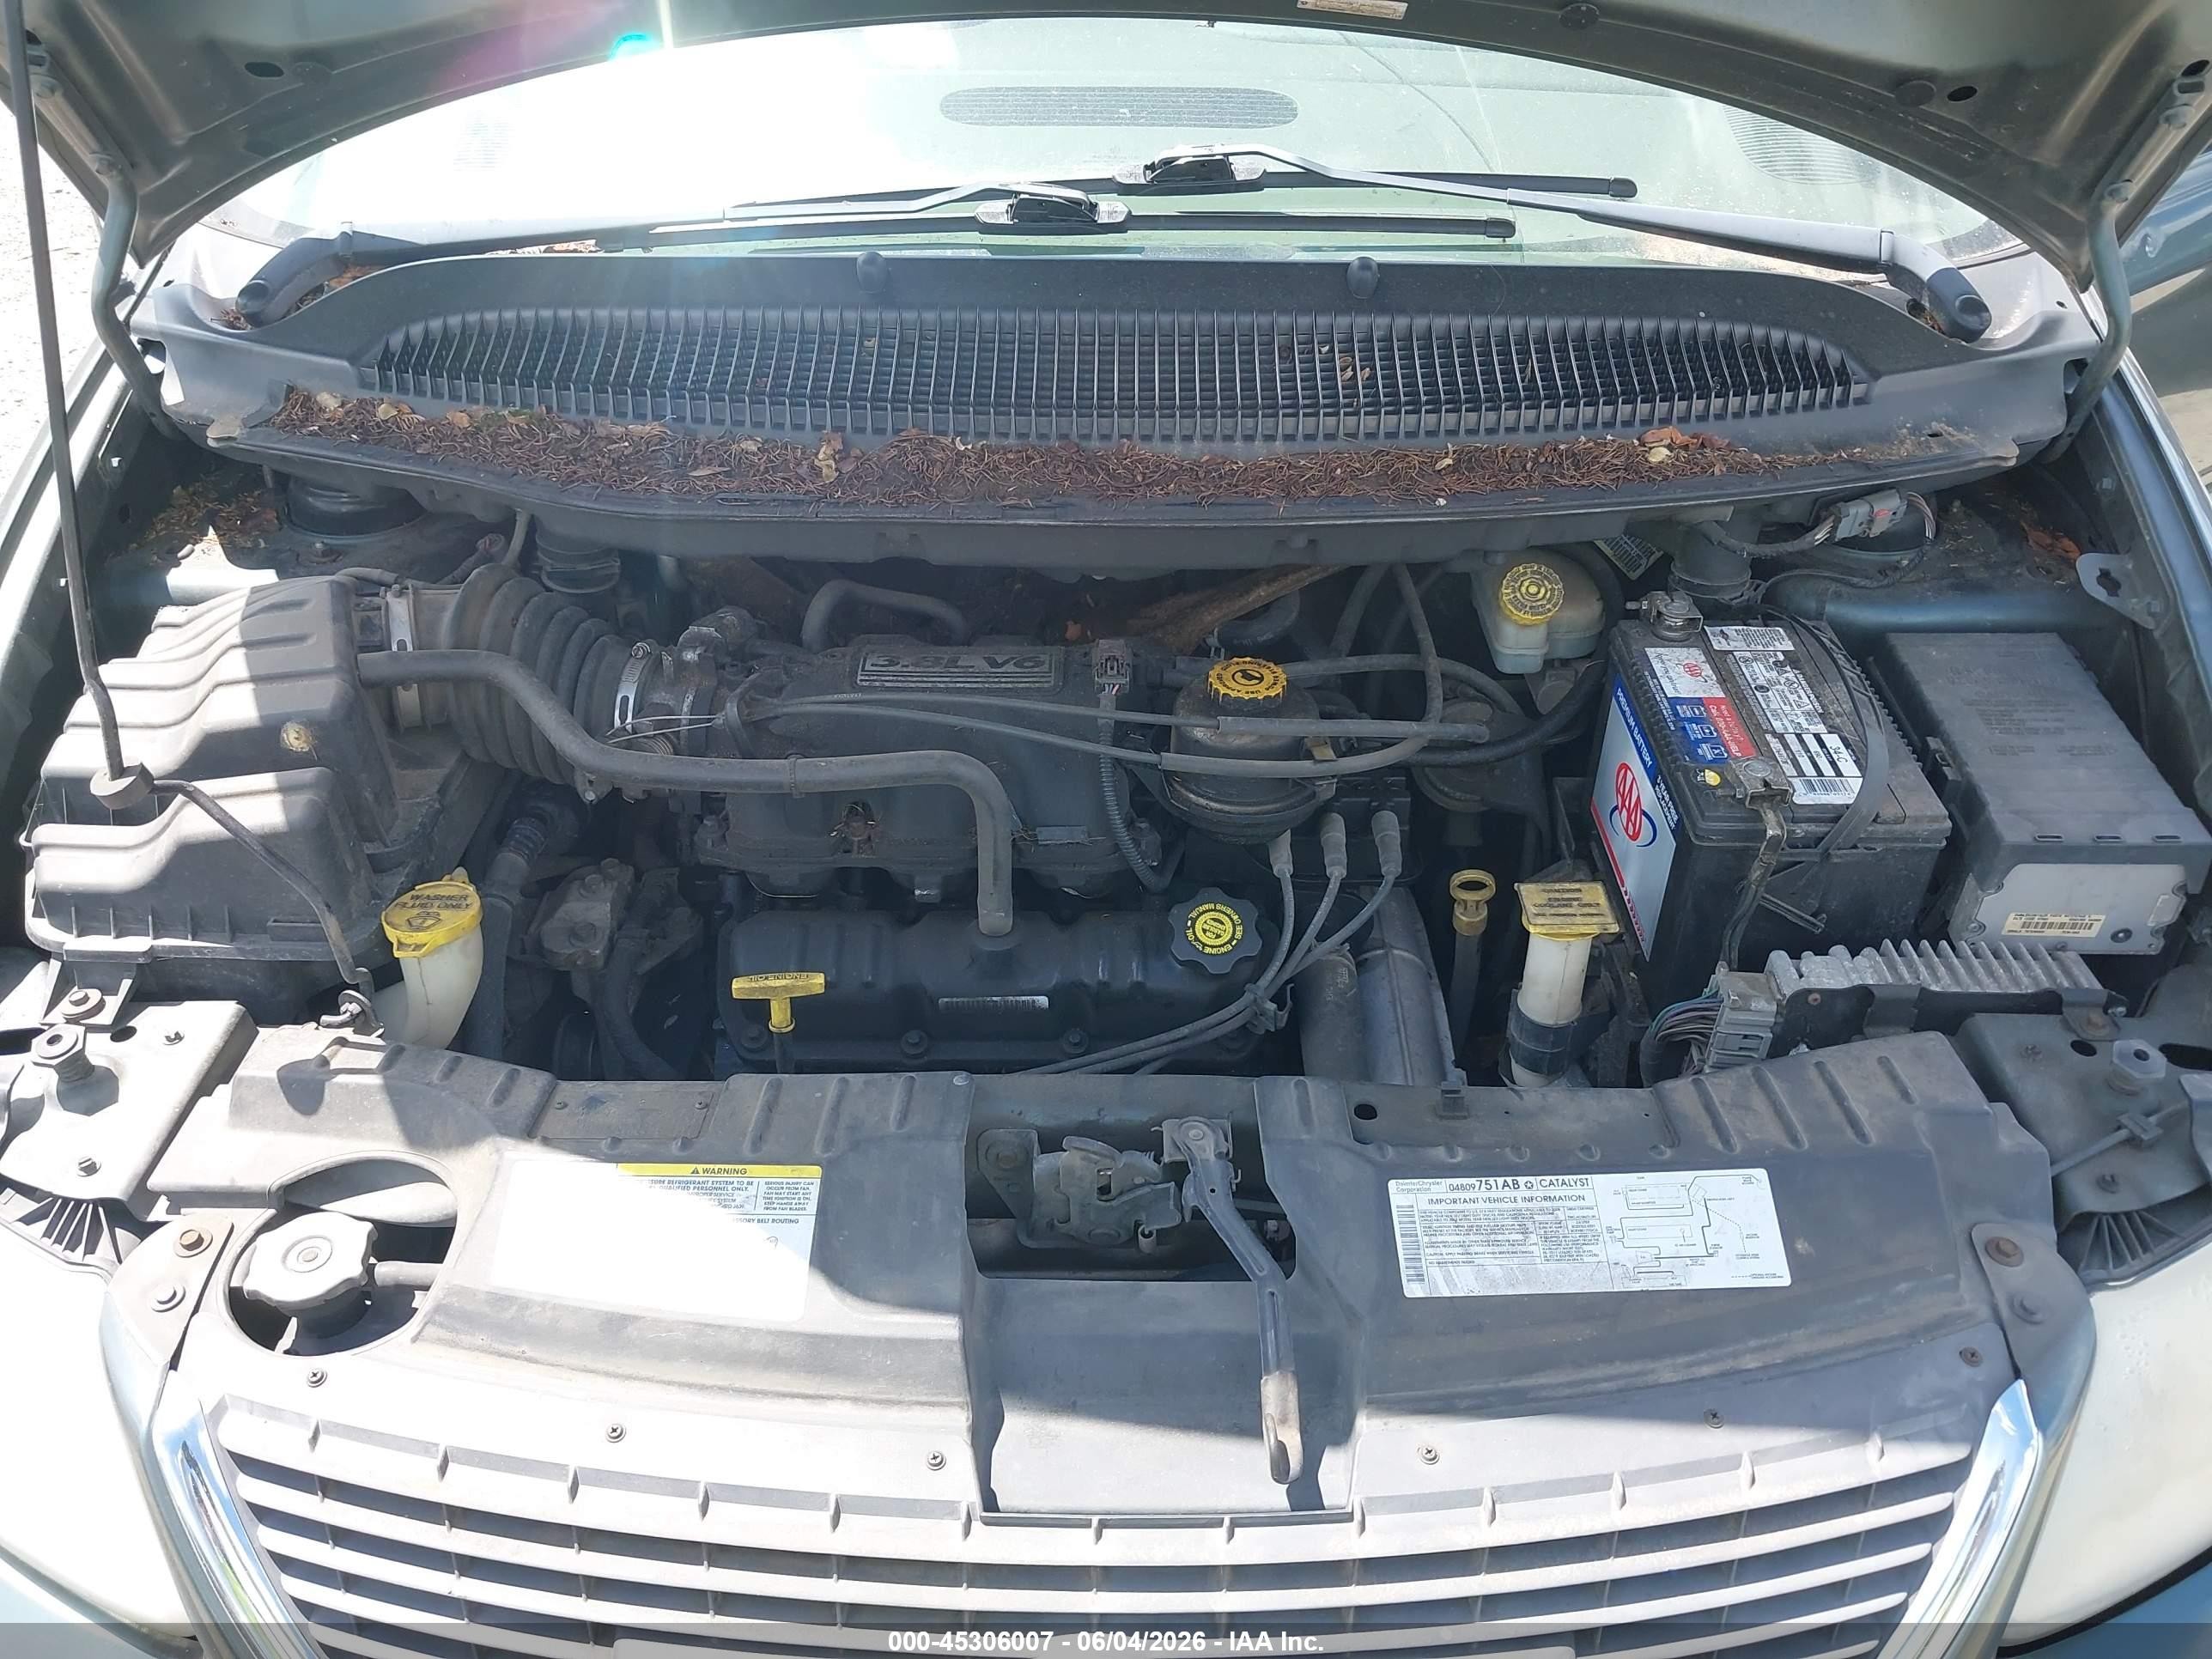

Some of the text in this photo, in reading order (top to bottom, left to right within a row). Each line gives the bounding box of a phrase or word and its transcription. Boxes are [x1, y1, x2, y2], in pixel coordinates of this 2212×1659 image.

[982, 655, 1046, 669] V6
[1616, 688, 1653, 768] PREMIUM BATTERY
[1616, 764, 1642, 840] AAA
[1188, 902, 1243, 939] SEE OWNERS MANUAL
[1185, 927, 1233, 955] ENGINE OIL
[1539, 1177, 1589, 1188] CATALYST
[1428, 1197, 1480, 1206] IMPORTANT
[1521, 1194, 1586, 1203] INFORMATION
